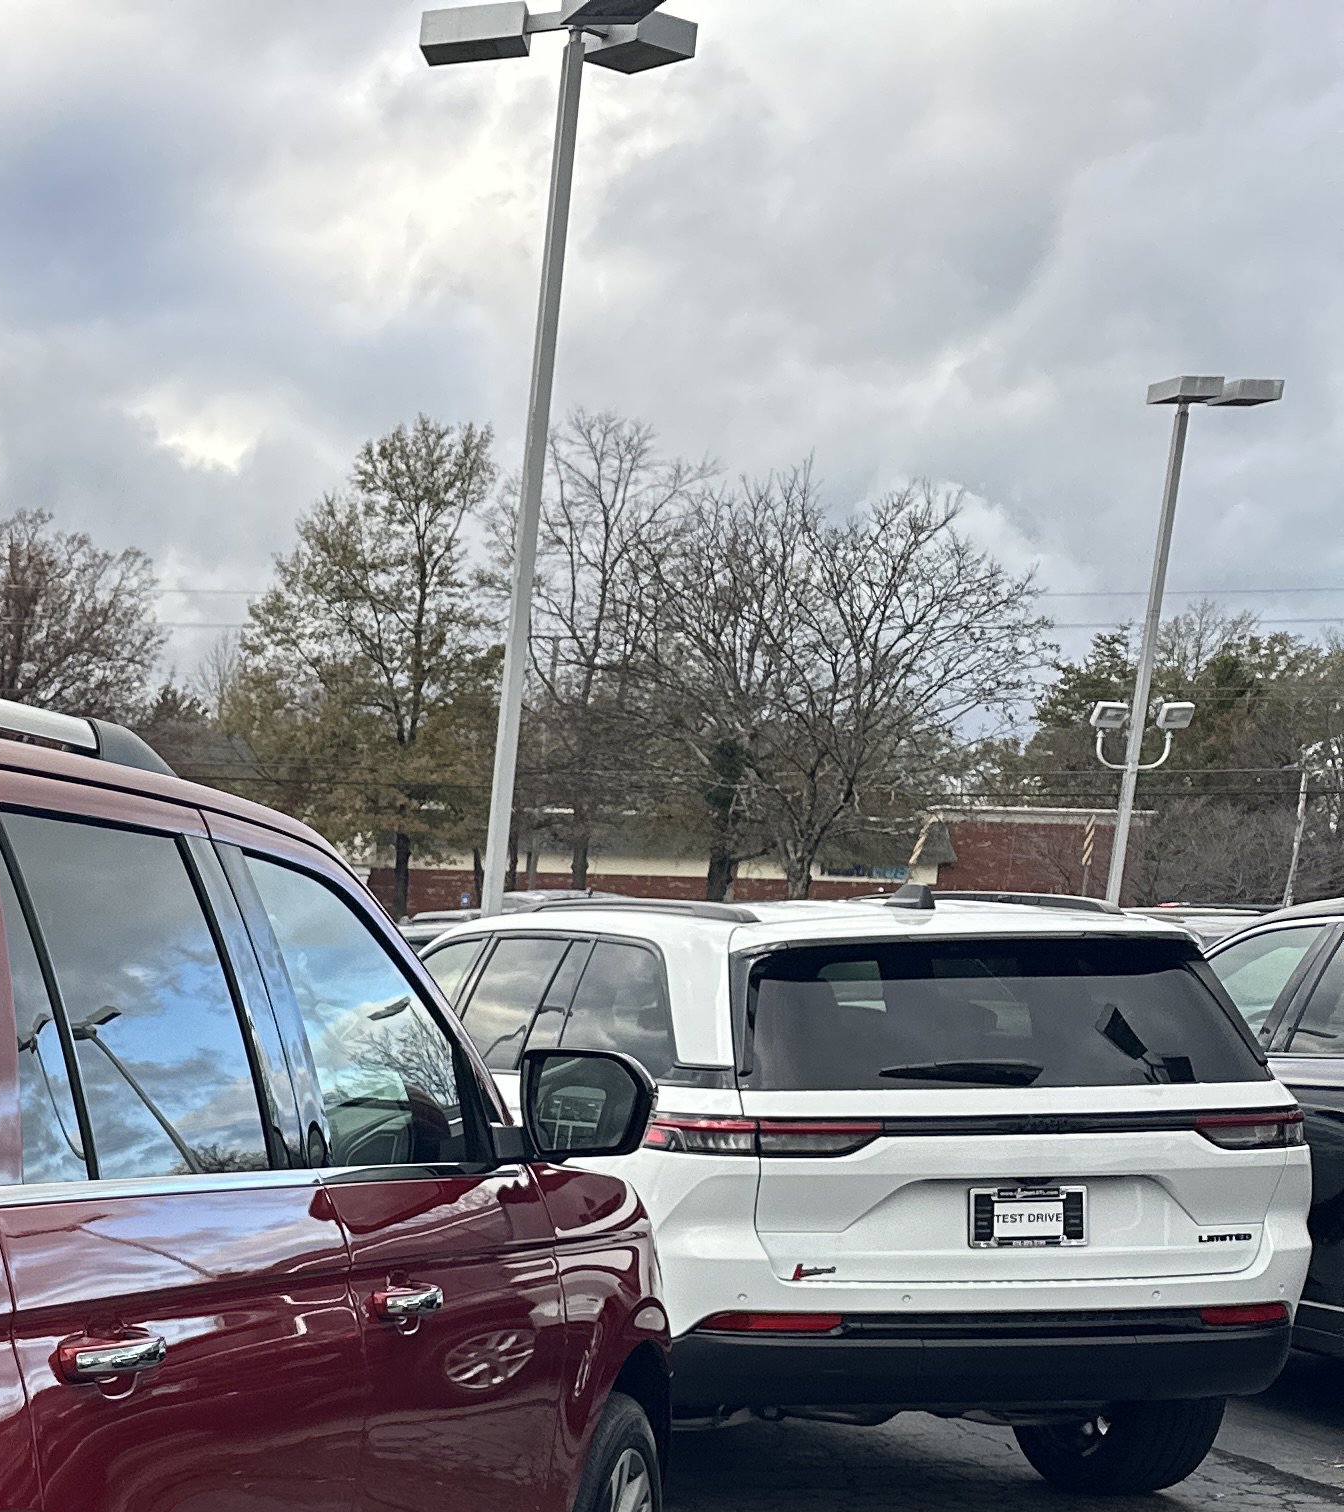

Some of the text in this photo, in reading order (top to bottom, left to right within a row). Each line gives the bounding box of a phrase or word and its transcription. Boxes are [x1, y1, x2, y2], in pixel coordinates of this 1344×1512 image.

[995, 1212, 1062, 1223] TEST DRIVE
[1198, 1233, 1252, 1243] LIMITED
